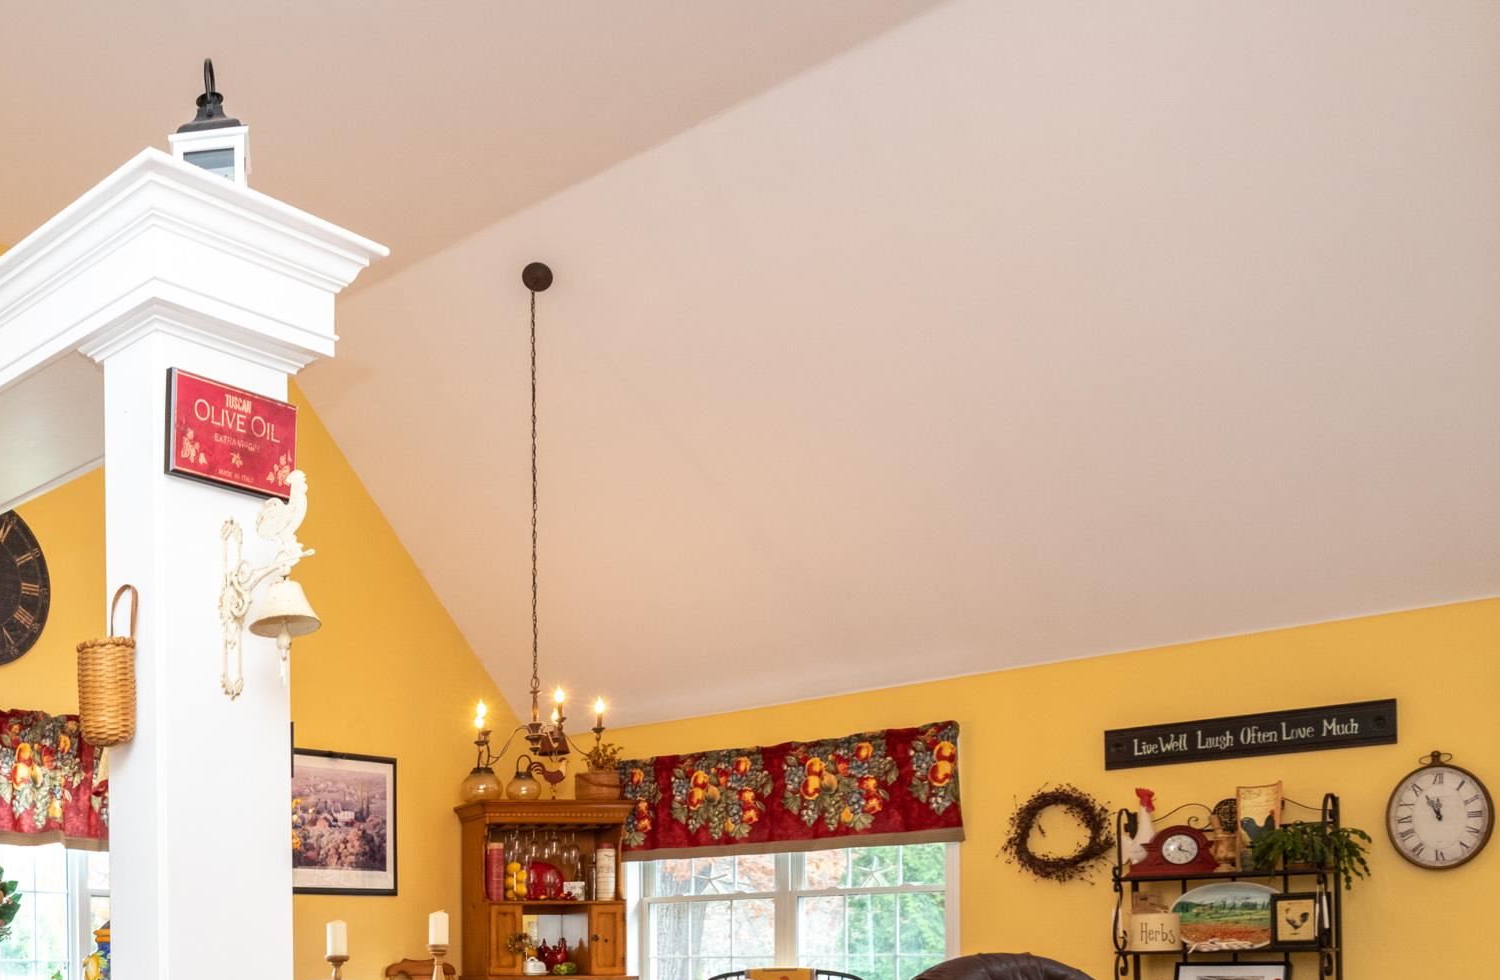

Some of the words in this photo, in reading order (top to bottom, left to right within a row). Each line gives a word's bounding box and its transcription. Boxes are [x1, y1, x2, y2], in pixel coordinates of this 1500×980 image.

[225, 394, 251, 413] TUSCAN
[194, 398, 246, 433] OLIVE
[251, 416, 280, 443] OIL
[214, 433, 236, 445] EXTRA
[1133, 739, 1158, 756] Live
[1158, 733, 1188, 752] Well
[1197, 730, 1234, 750] Laugh
[1240, 726, 1277, 745] Often
[1281, 722, 1314, 741] Love
[1321, 718, 1359, 737] Much
[1140, 922, 1176, 944] Herbs
